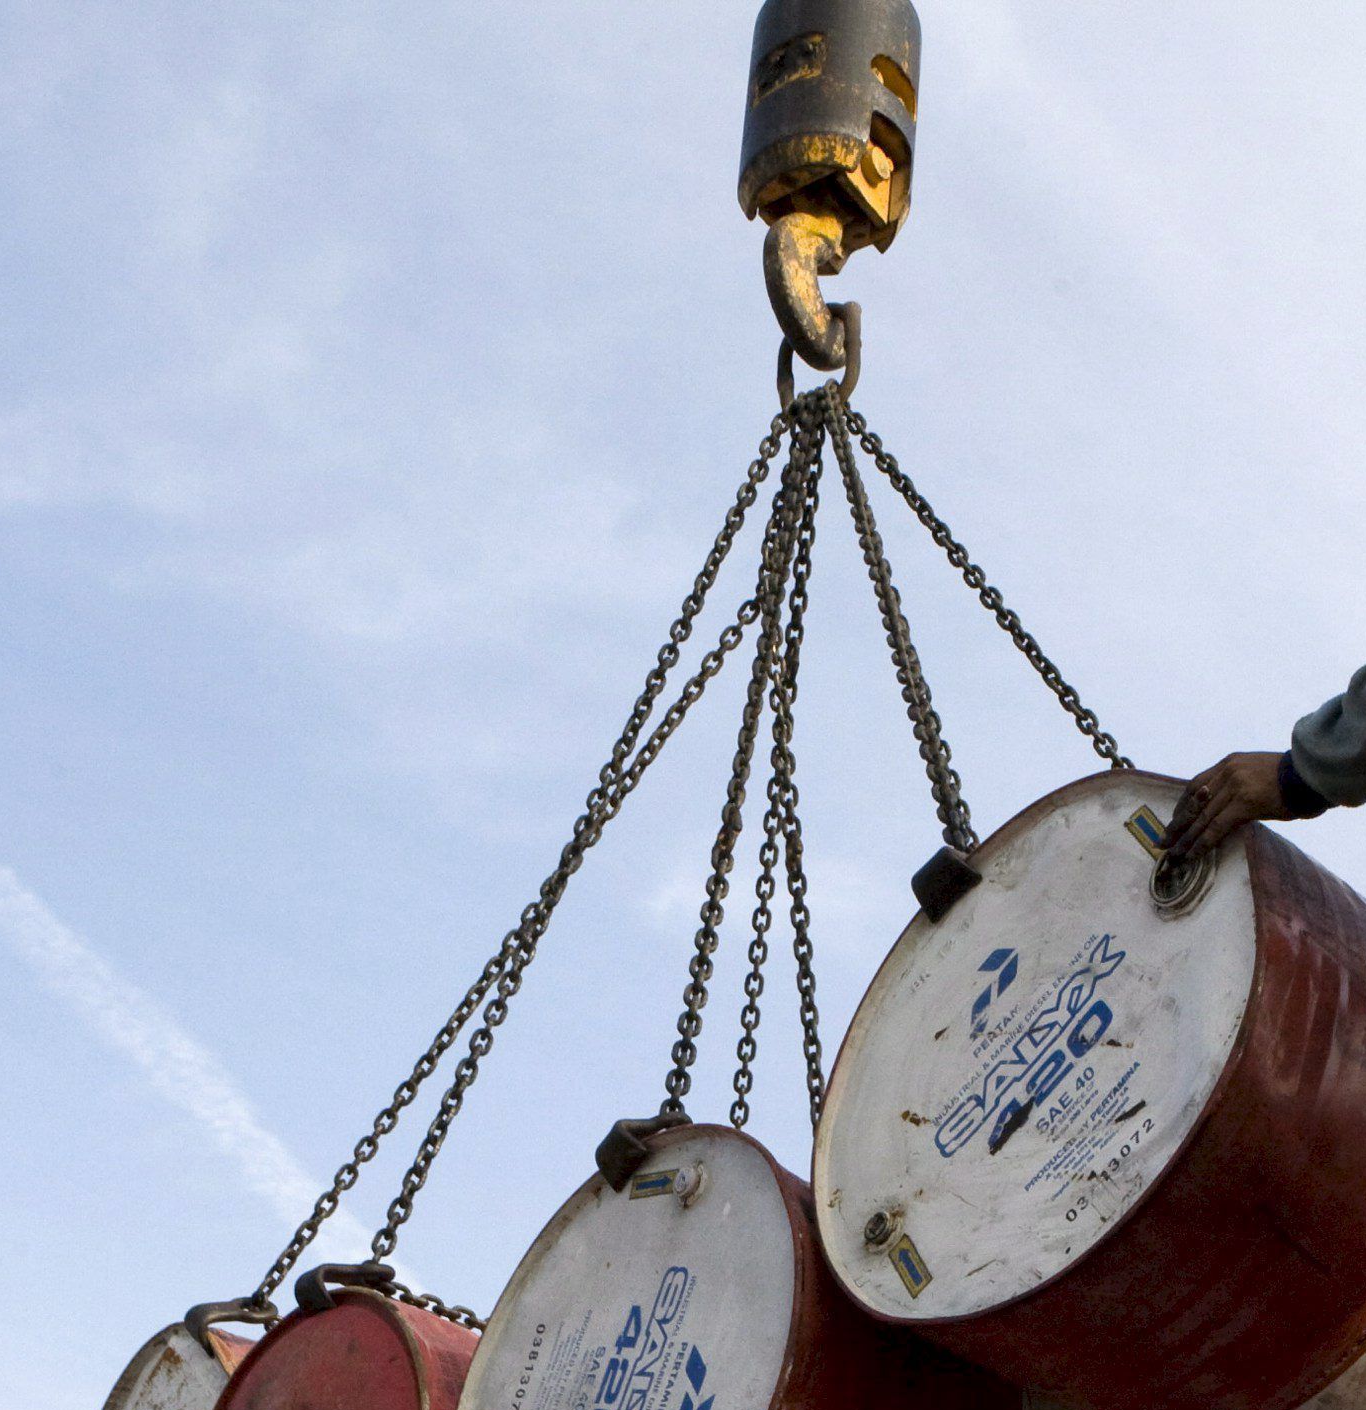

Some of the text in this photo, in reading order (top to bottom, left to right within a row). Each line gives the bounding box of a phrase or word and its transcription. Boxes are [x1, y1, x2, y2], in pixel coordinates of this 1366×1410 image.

[934, 934, 1126, 1158] SALYX
[930, 1072, 982, 1127] INDUSTRIAL
[1036, 1067, 1094, 1134] SAE 40
[1090, 1062, 1140, 1121] PERTAMINA
[1066, 1119, 1154, 1222] 0313072
